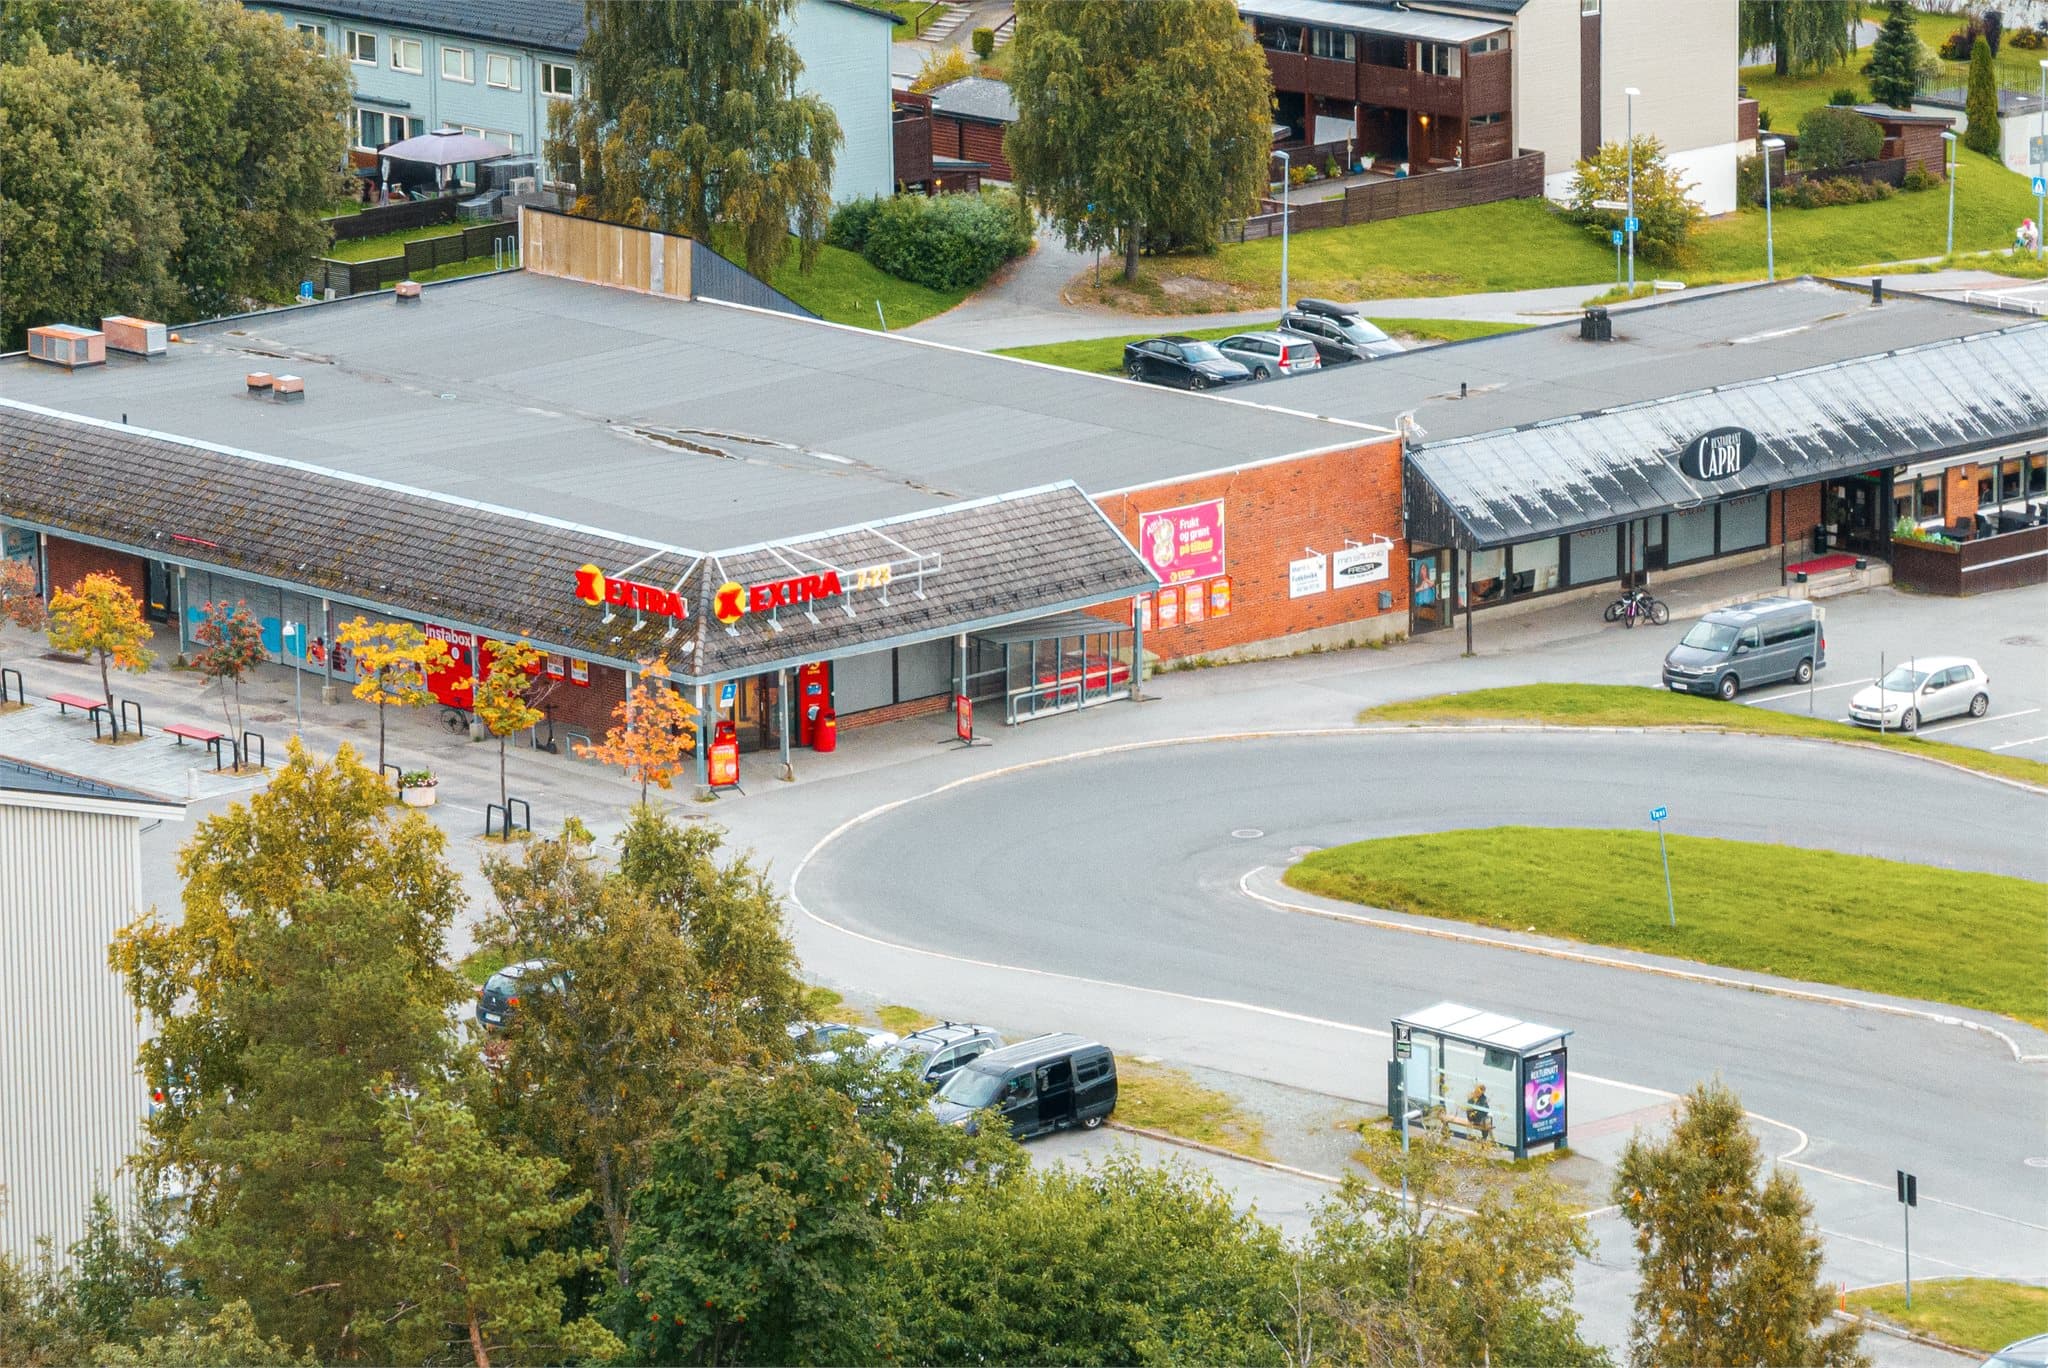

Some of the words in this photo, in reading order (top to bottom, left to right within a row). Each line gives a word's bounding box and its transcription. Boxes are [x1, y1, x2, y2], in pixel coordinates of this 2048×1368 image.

[1699, 436, 1740, 478] CAPRI
[1179, 532, 1189, 543] og
[1180, 518, 1199, 530] Frukt
[605, 576, 685, 620] EXTRA
[750, 570, 842, 612] EXTRA
